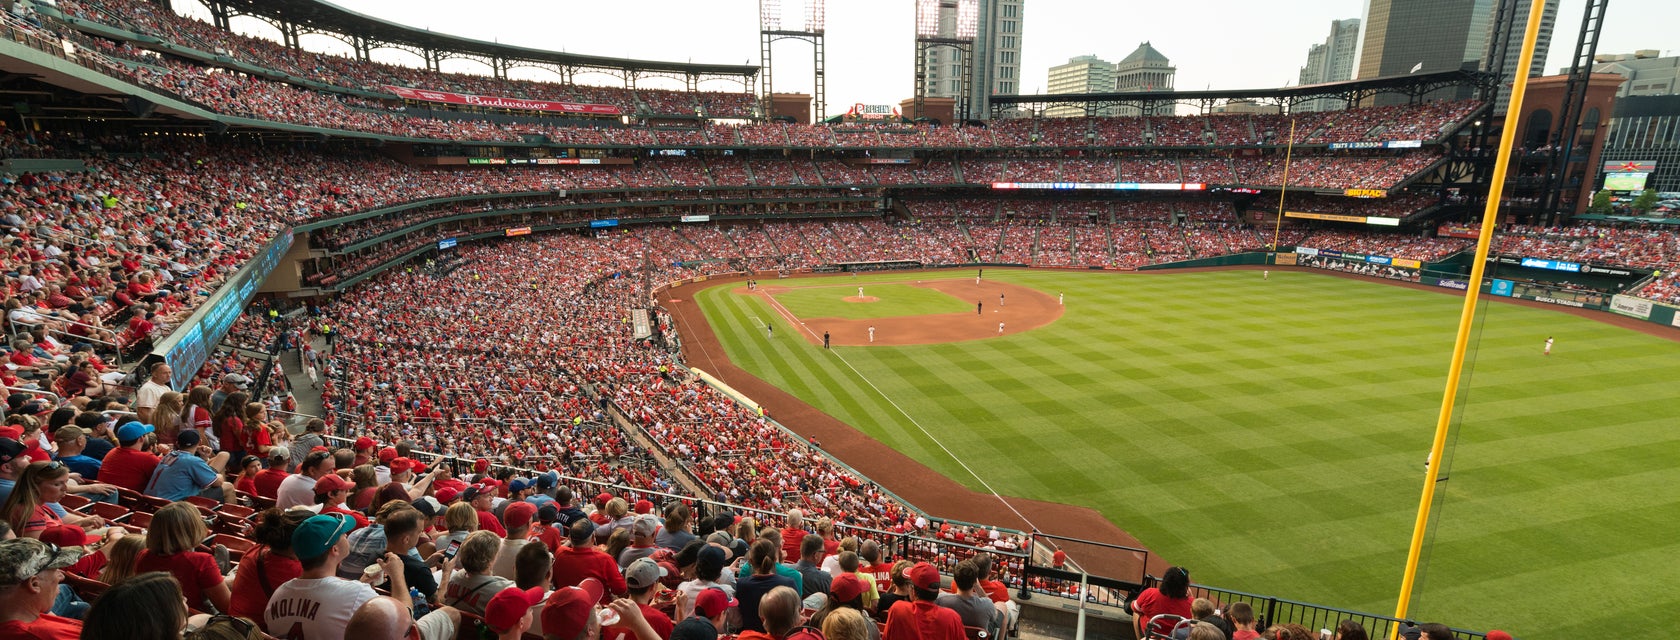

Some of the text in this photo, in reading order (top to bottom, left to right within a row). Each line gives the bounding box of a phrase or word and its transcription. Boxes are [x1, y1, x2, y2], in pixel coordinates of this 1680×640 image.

[466, 95, 549, 109] Budweiser
[1439, 280, 1467, 290] Scottrade
[1535, 295, 1584, 308] BUSCH STADIUM
[270, 598, 320, 621] MOLINA
